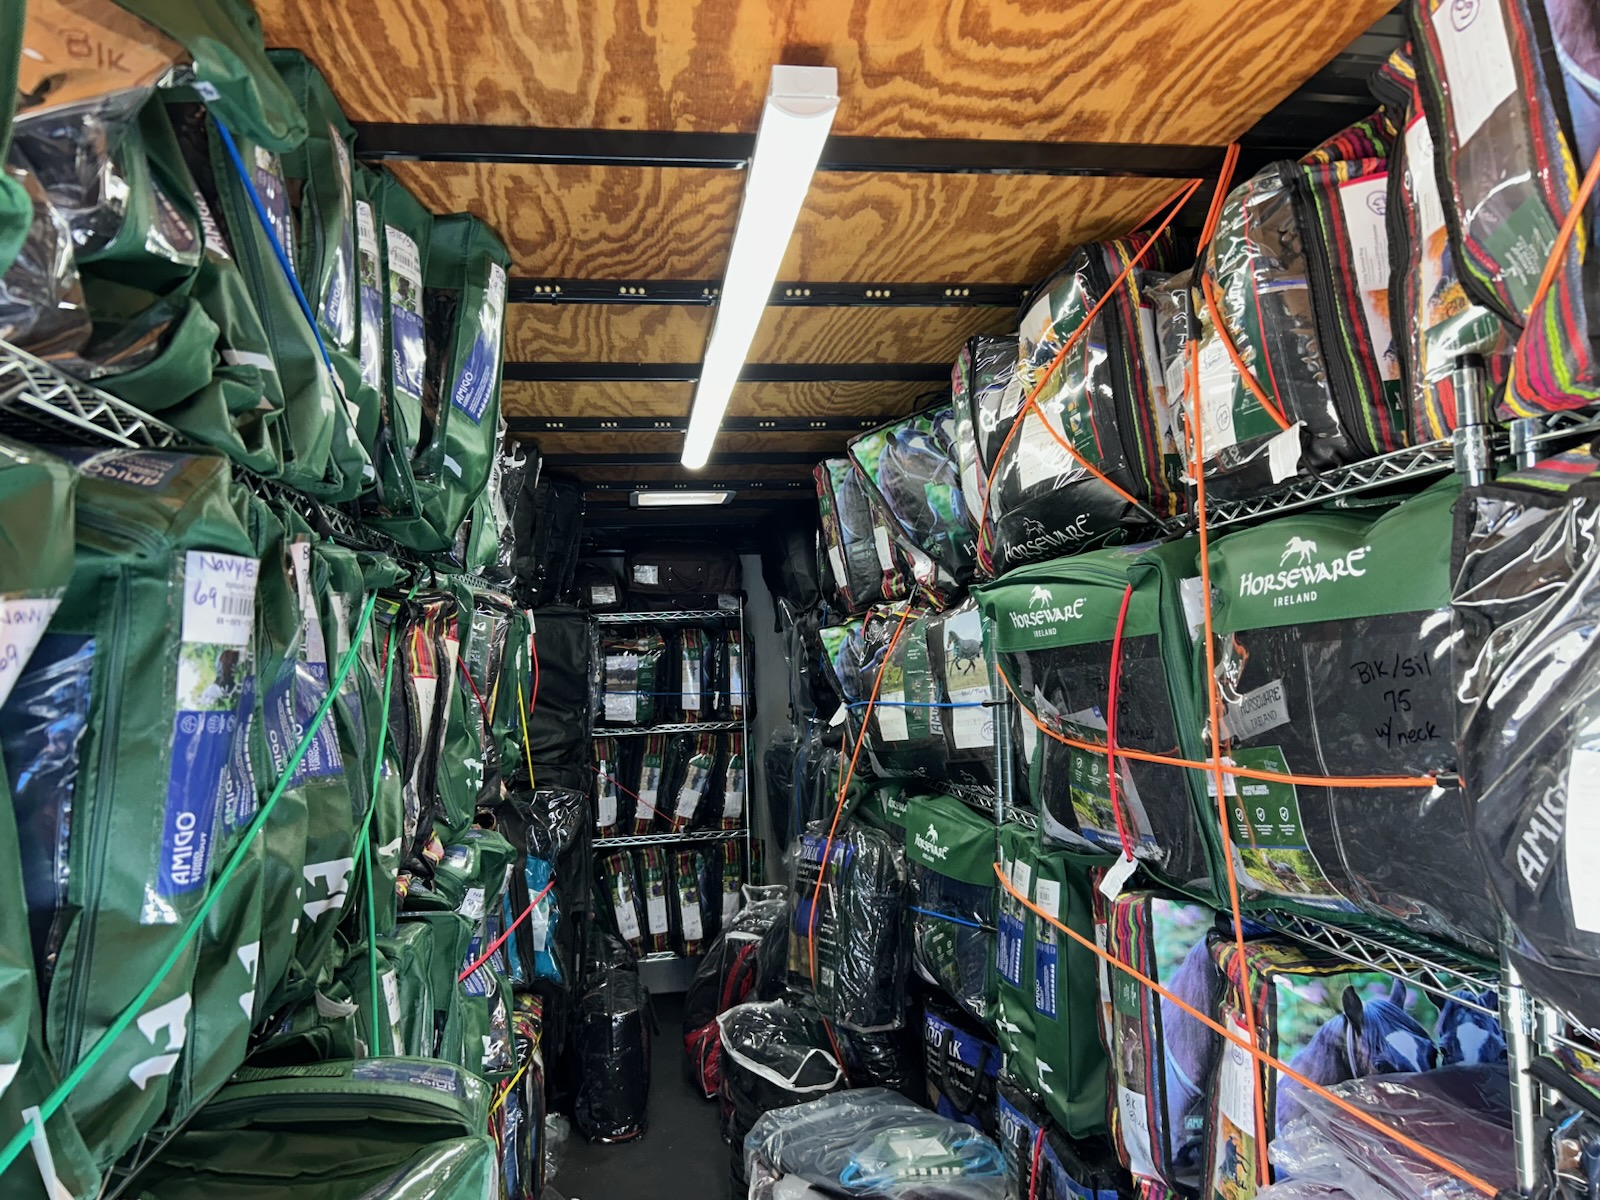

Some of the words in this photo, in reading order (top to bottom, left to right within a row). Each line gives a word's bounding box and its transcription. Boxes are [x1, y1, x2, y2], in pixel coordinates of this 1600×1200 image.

[455, 371, 474, 405] AMIGO
[1004, 513, 1095, 561] HORSEWARE
[1239, 547, 1367, 597] HORSEWARE
[193, 584, 217, 609] 69
[1273, 590, 1318, 608] IRELAND
[1009, 598, 1085, 630] HORSEWARE
[1033, 627, 1057, 638] IRELAND
[1239, 686, 1282, 716] HORSEWARE
[1384, 690, 1411, 713] 75
[1250, 709, 1278, 730] IRELAND
[1396, 721, 1441, 745] neck
[170, 811, 197, 886] AMIGO
